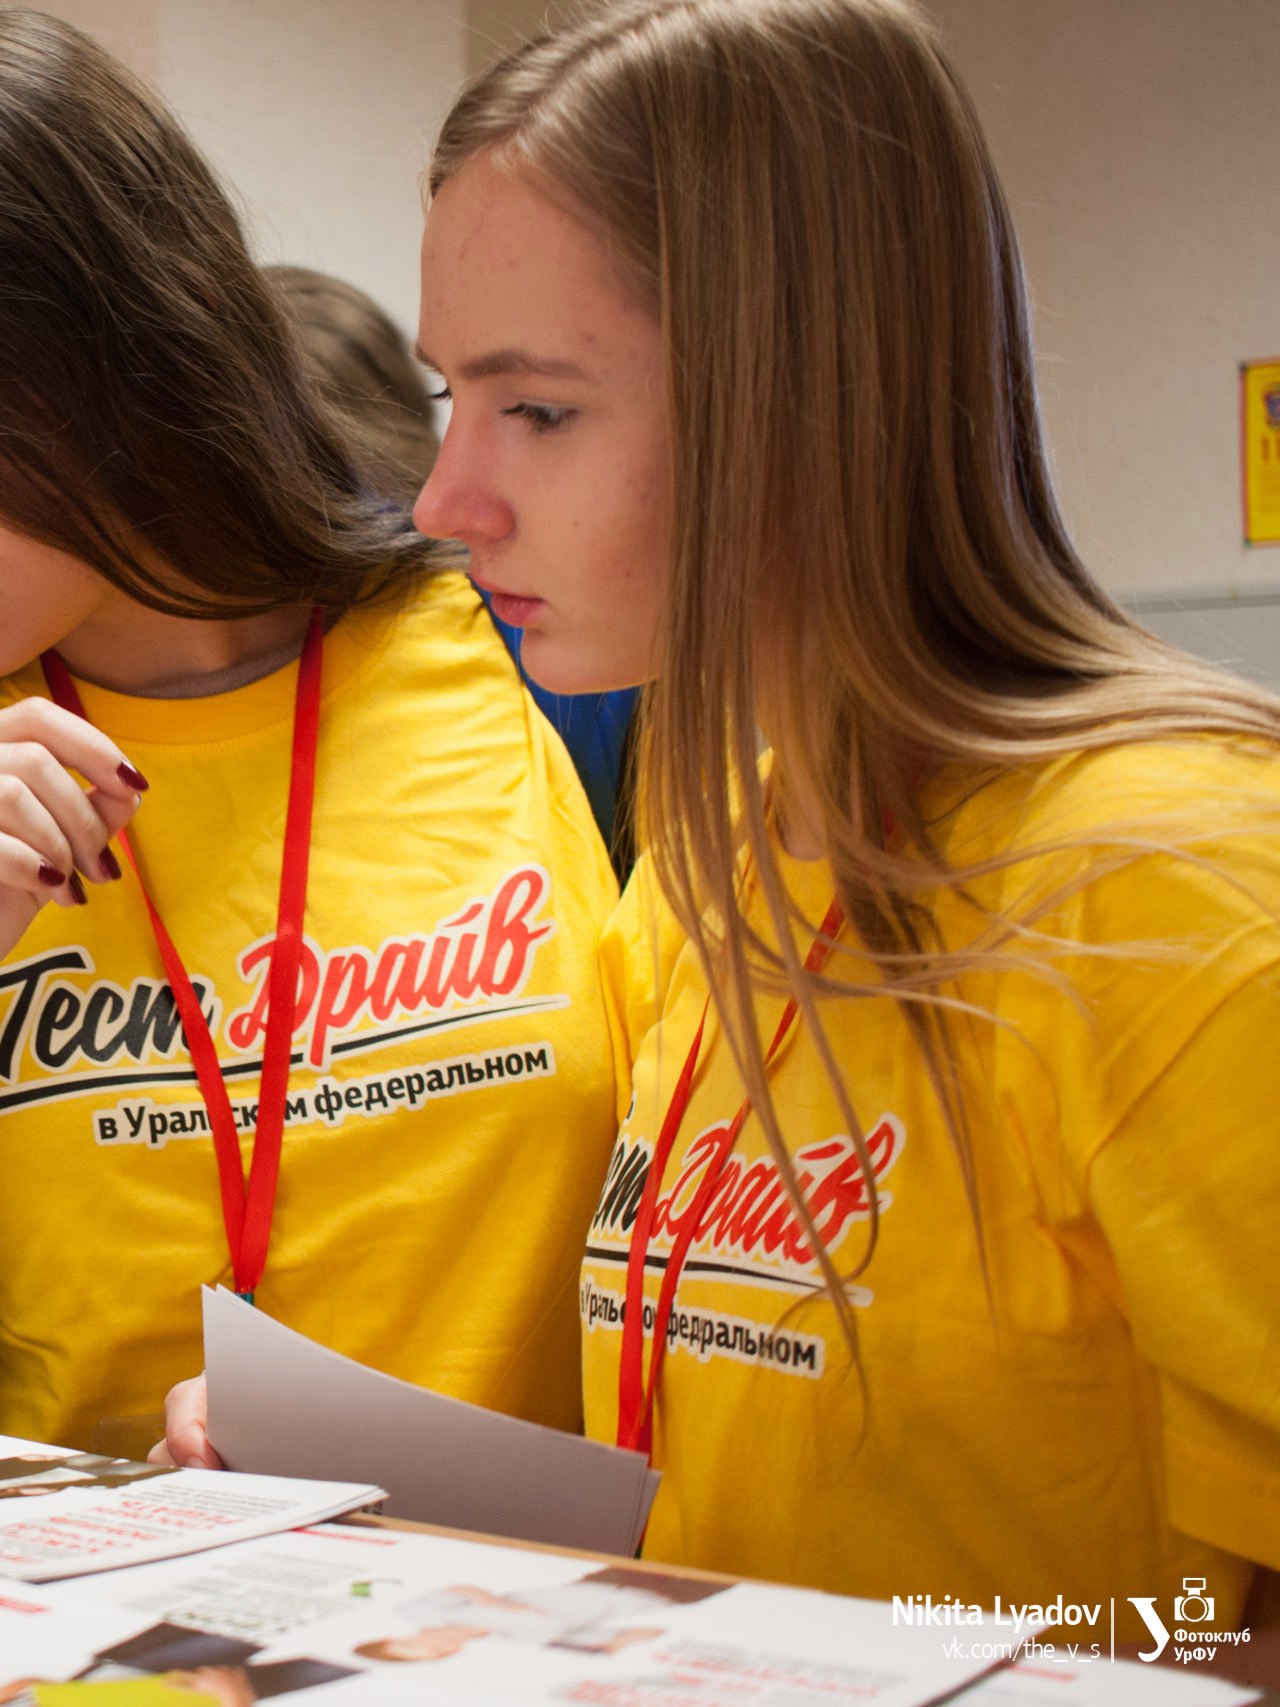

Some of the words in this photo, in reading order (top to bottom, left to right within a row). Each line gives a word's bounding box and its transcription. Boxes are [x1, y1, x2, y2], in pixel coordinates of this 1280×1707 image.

[228, 869, 551, 1067] Драйв
[98, 1117, 118, 1139] в
[123, 1105, 307, 1143] Уралскм
[314, 1047, 549, 1121] федеральном
